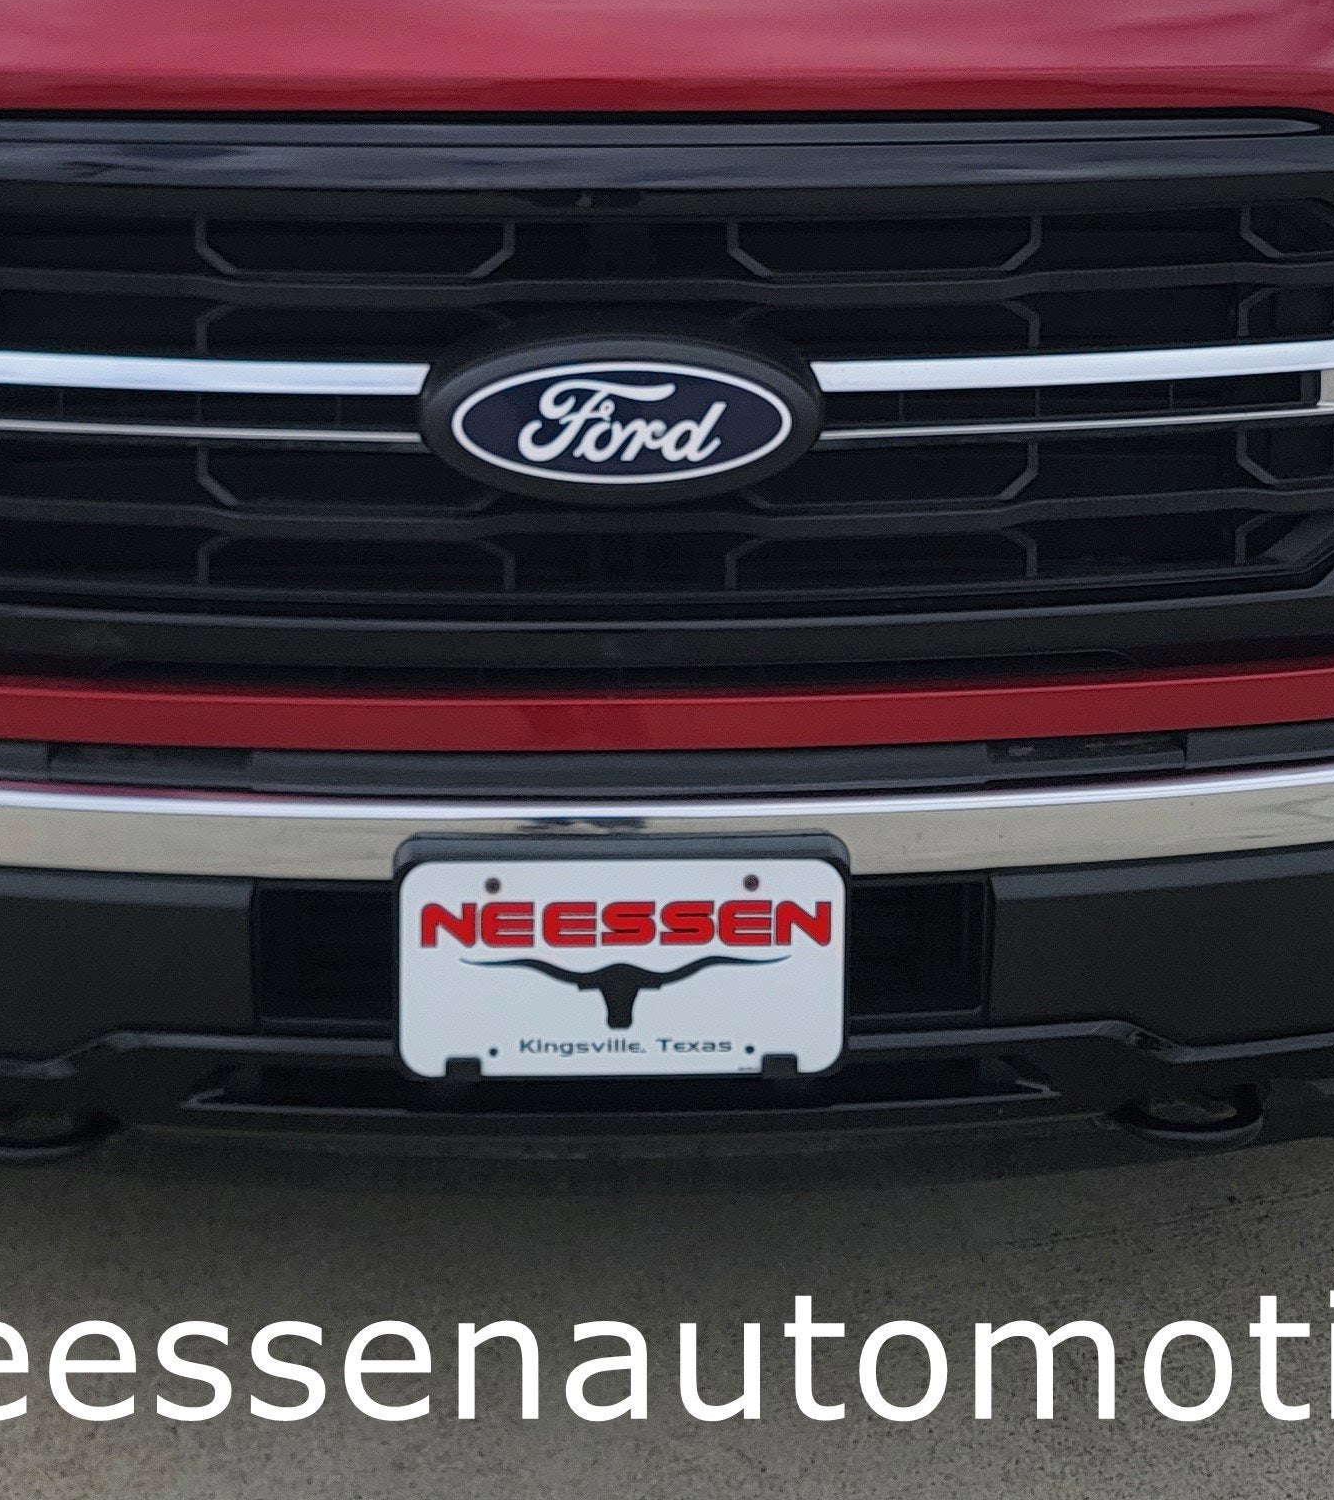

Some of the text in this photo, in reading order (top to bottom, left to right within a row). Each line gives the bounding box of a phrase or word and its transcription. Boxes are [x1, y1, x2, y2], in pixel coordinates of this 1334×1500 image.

[517, 378, 727, 463] Ford
[421, 900, 831, 947] NEESSEN
[656, 1038, 732, 1053] Texas
